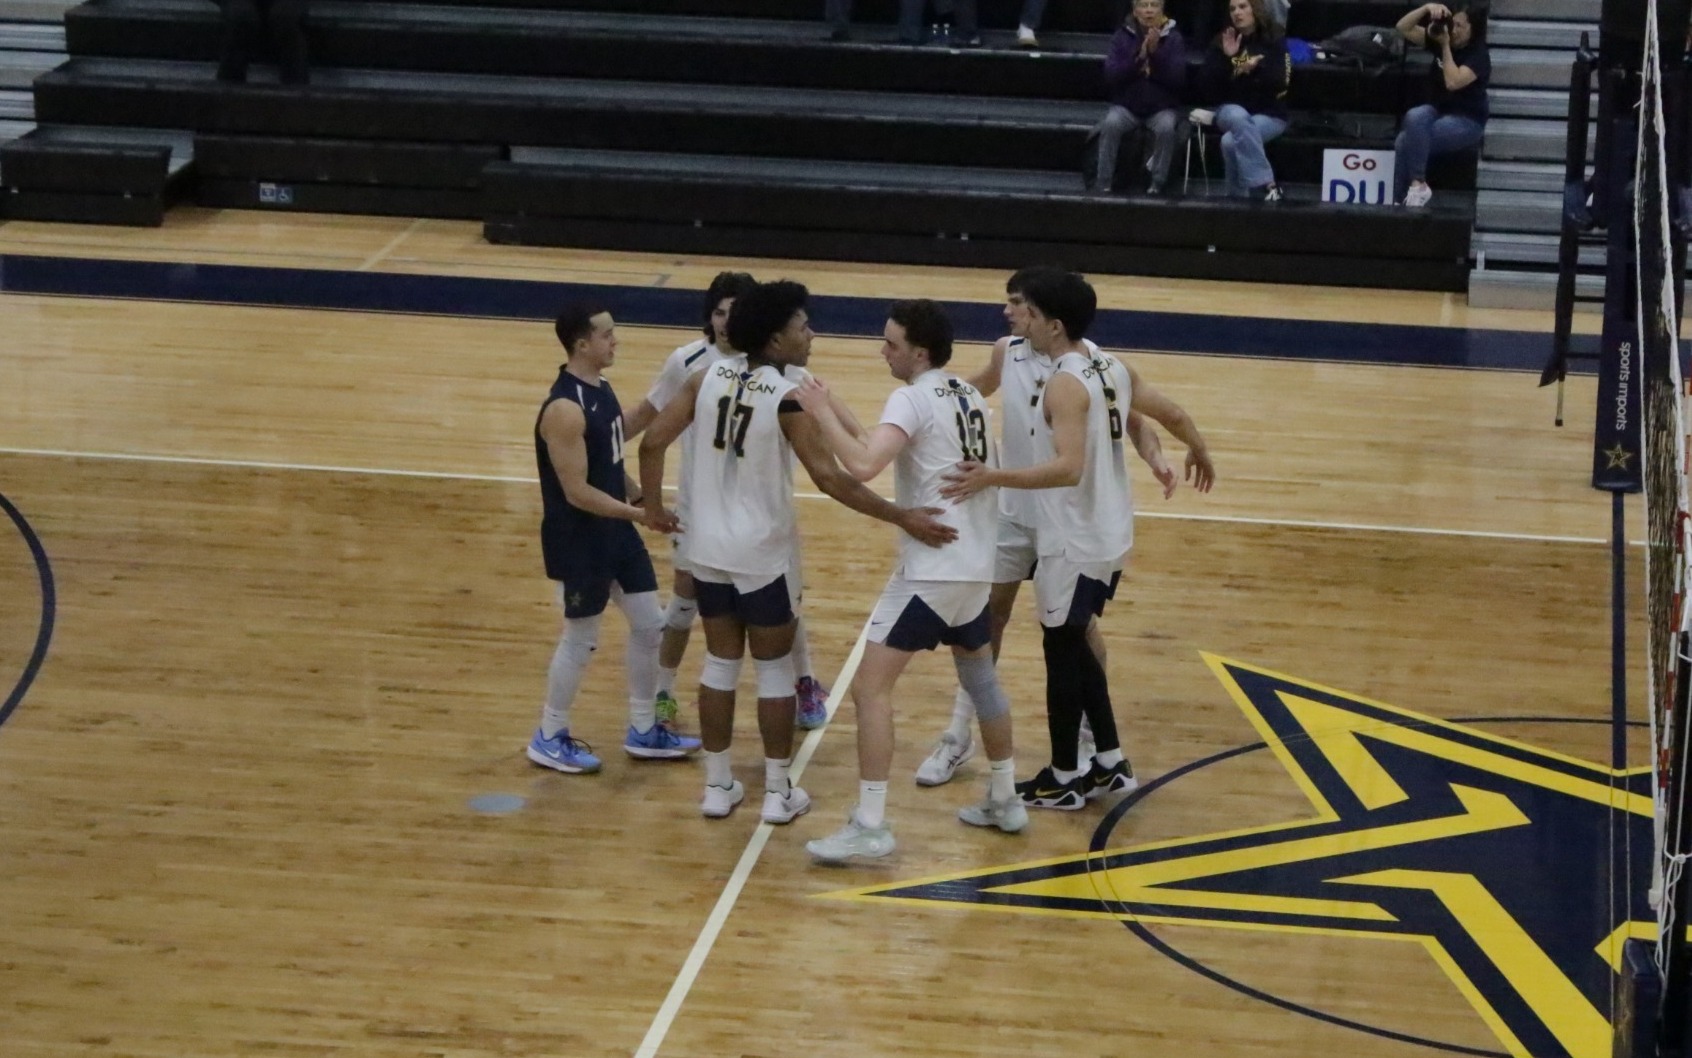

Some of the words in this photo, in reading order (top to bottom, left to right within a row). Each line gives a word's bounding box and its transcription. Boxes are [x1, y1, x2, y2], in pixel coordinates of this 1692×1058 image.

[1343, 153, 1377, 171] Go
[1329, 179, 1385, 205] DU
[1618, 341, 1631, 381] sports
[713, 395, 755, 458] 17
[1616, 382, 1629, 431] imports
[956, 408, 988, 463] 13
